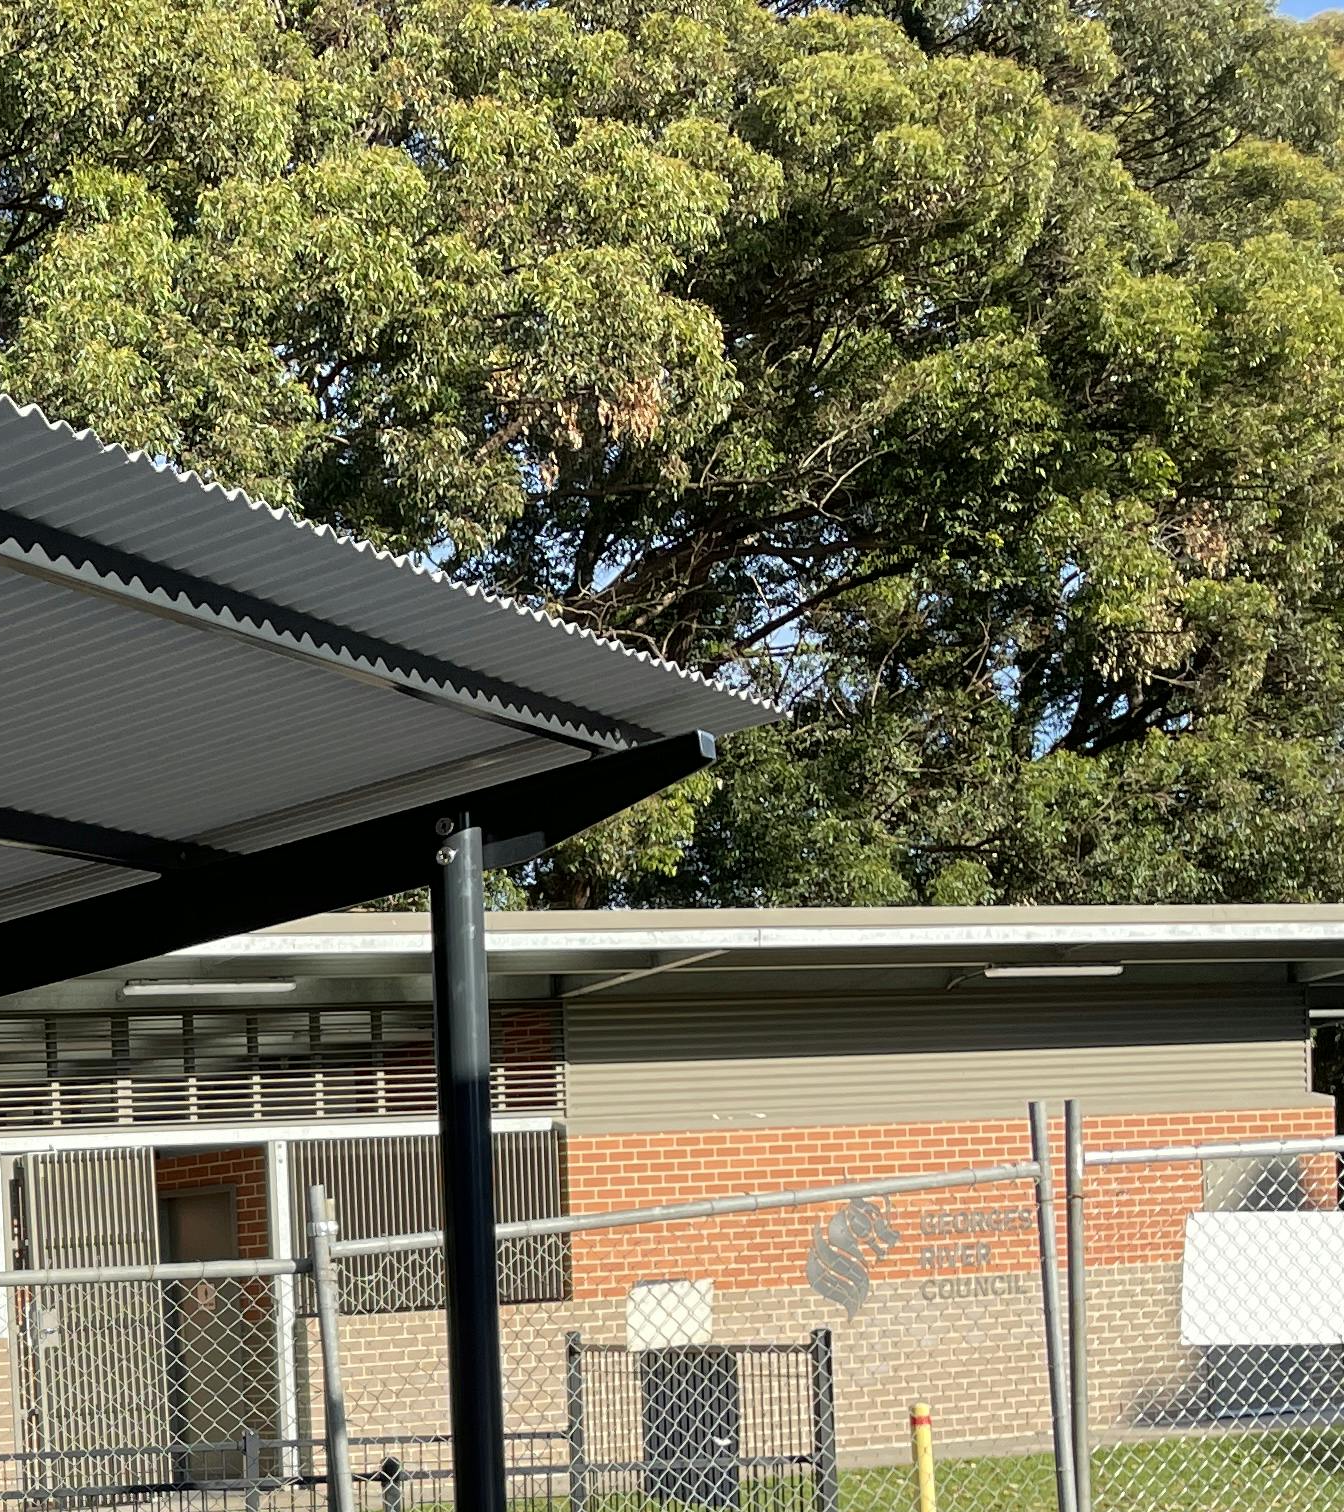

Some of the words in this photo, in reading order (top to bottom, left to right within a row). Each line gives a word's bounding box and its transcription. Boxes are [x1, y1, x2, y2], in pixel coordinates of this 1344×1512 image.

[920, 1209, 1032, 1235] GEORGES
[920, 1241, 991, 1269] RIVER
[919, 1275, 1027, 1300] COUNCIL
